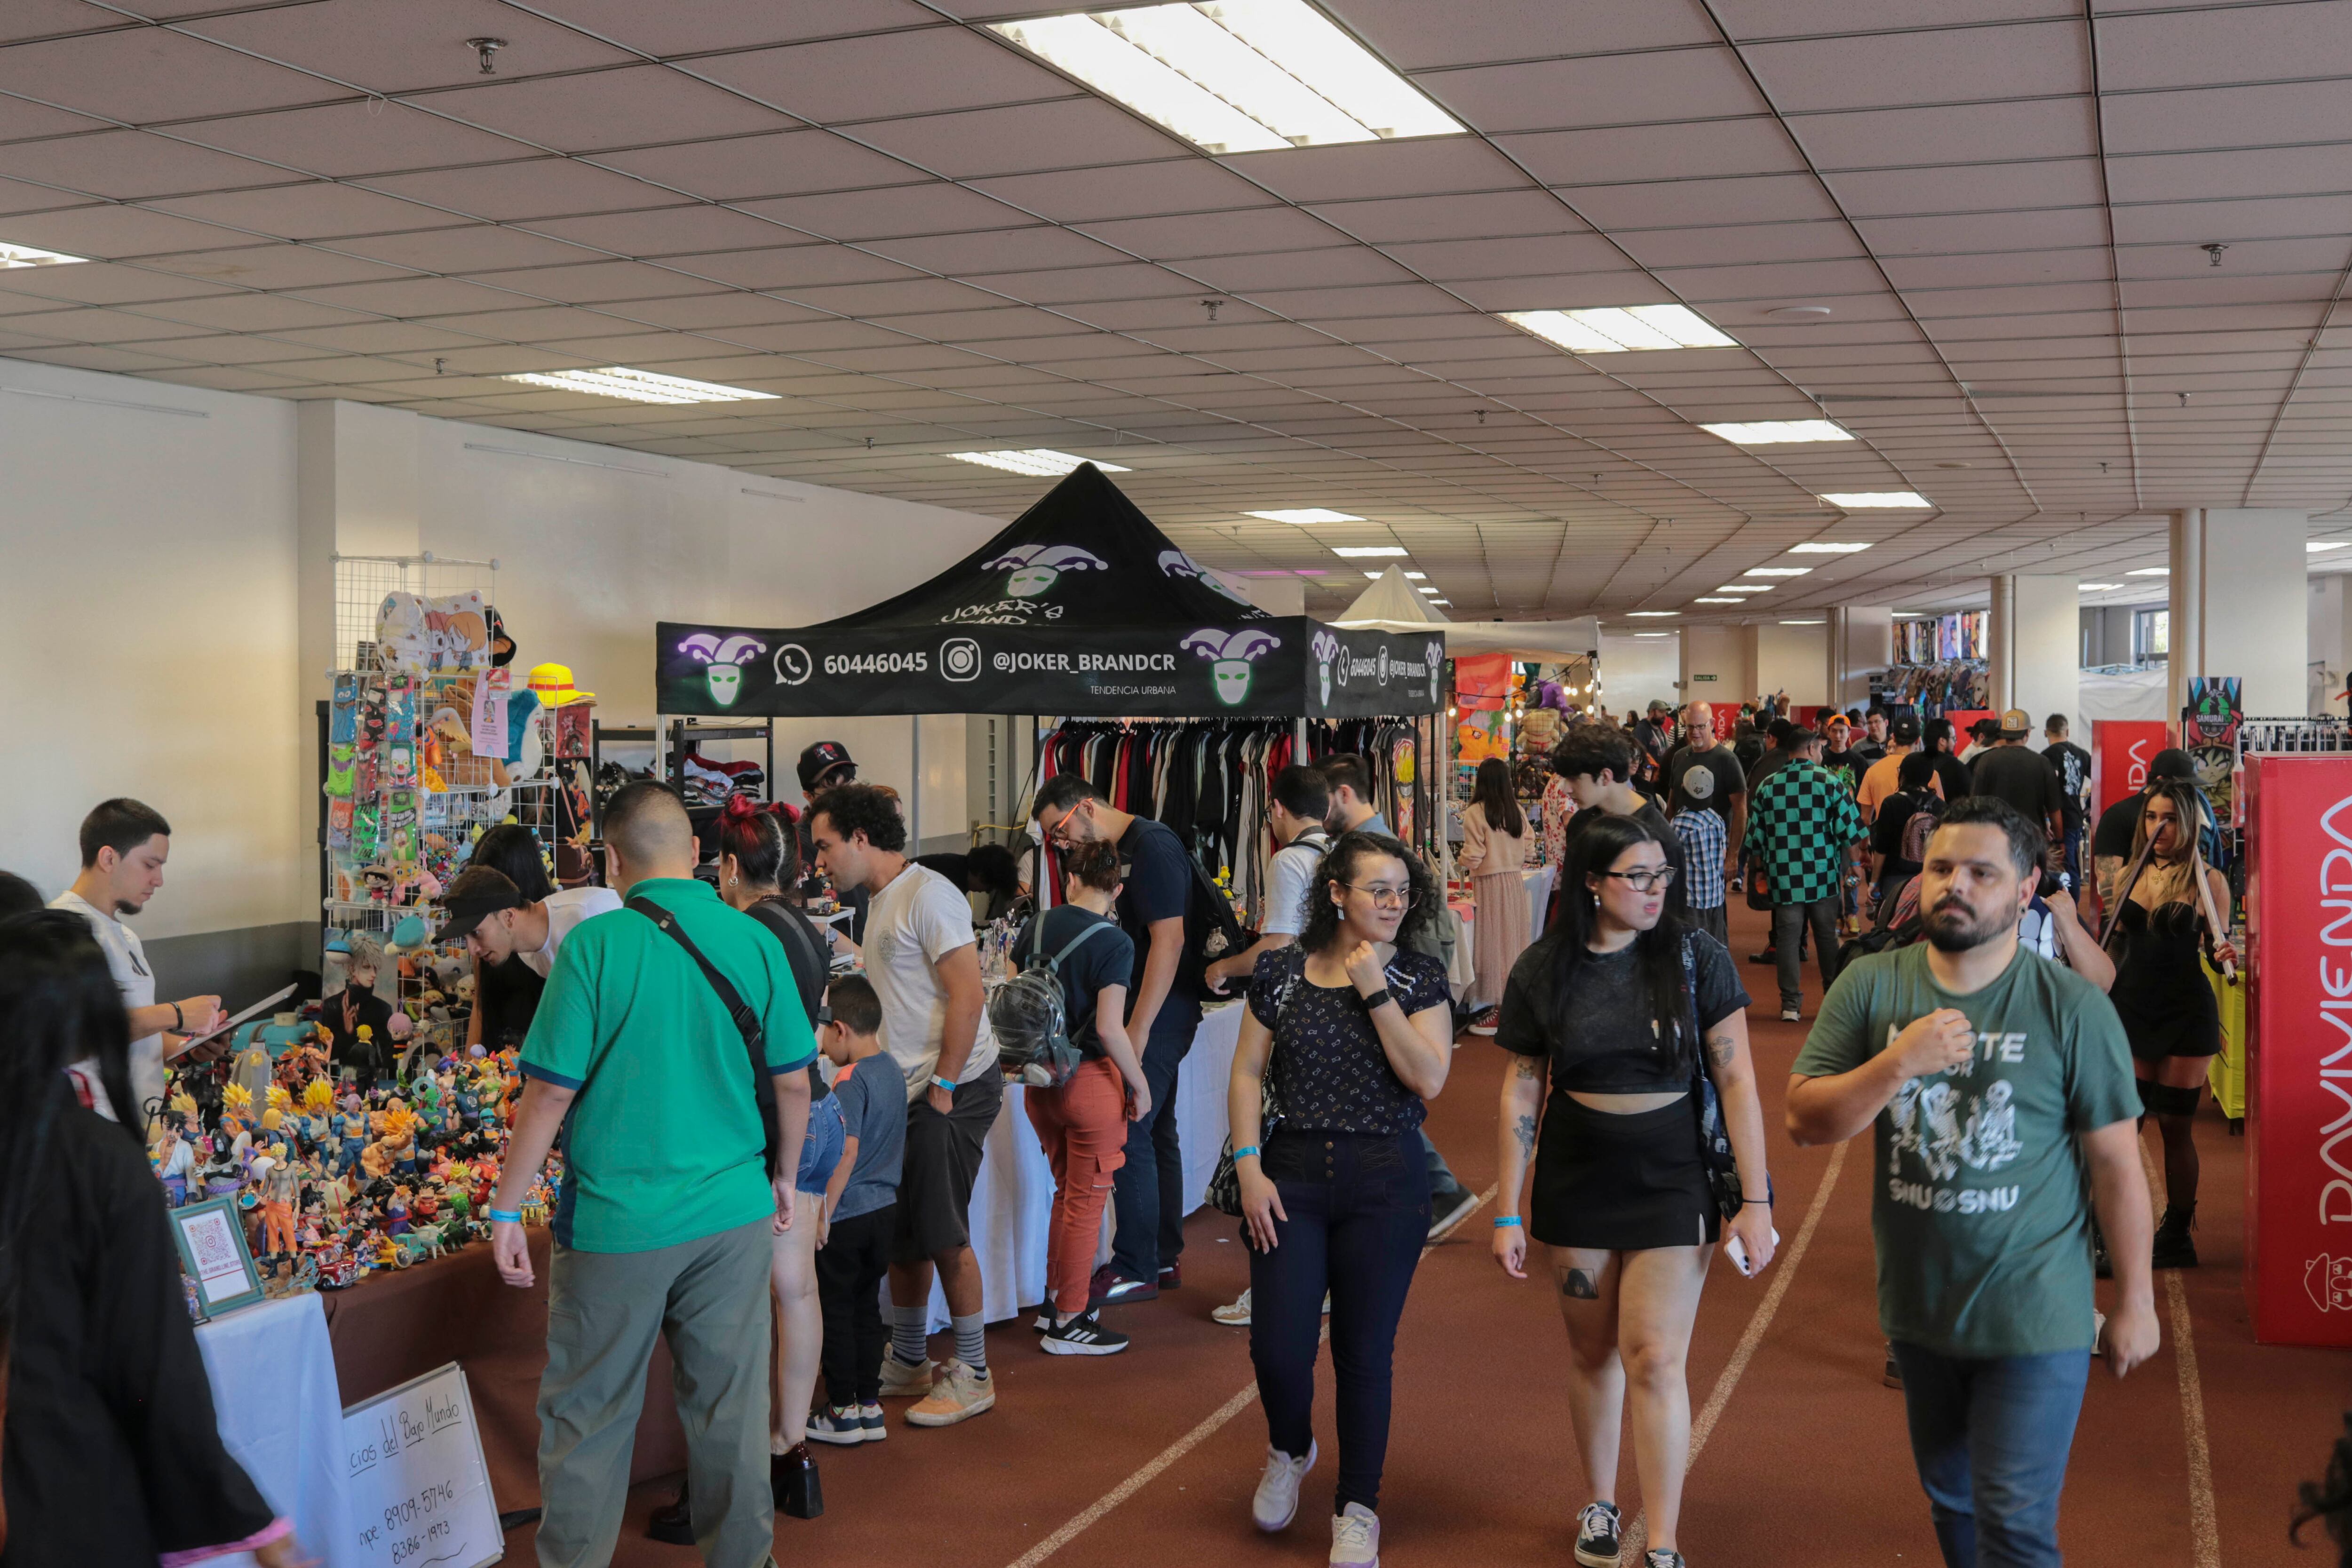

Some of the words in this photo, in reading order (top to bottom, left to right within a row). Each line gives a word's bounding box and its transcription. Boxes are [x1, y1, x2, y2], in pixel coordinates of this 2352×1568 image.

[824, 652, 927, 674] 60446045
[993, 652, 1176, 674] @JOKER_BRANDCR
[1351, 658, 1376, 676] 60446045
[1090, 685, 1139, 694] TENDENCIA
[1142, 686, 1176, 694] URBANA
[350, 1445, 376, 1468] cios
[382, 1415, 398, 1453] del
[399, 1411, 423, 1441] Bajo
[426, 1393, 459, 1429] Mundo
[360, 1525, 383, 1551] npe:
[385, 1480, 453, 1530] 8909-5746
[392, 1520, 450, 1564] 8386-1973
